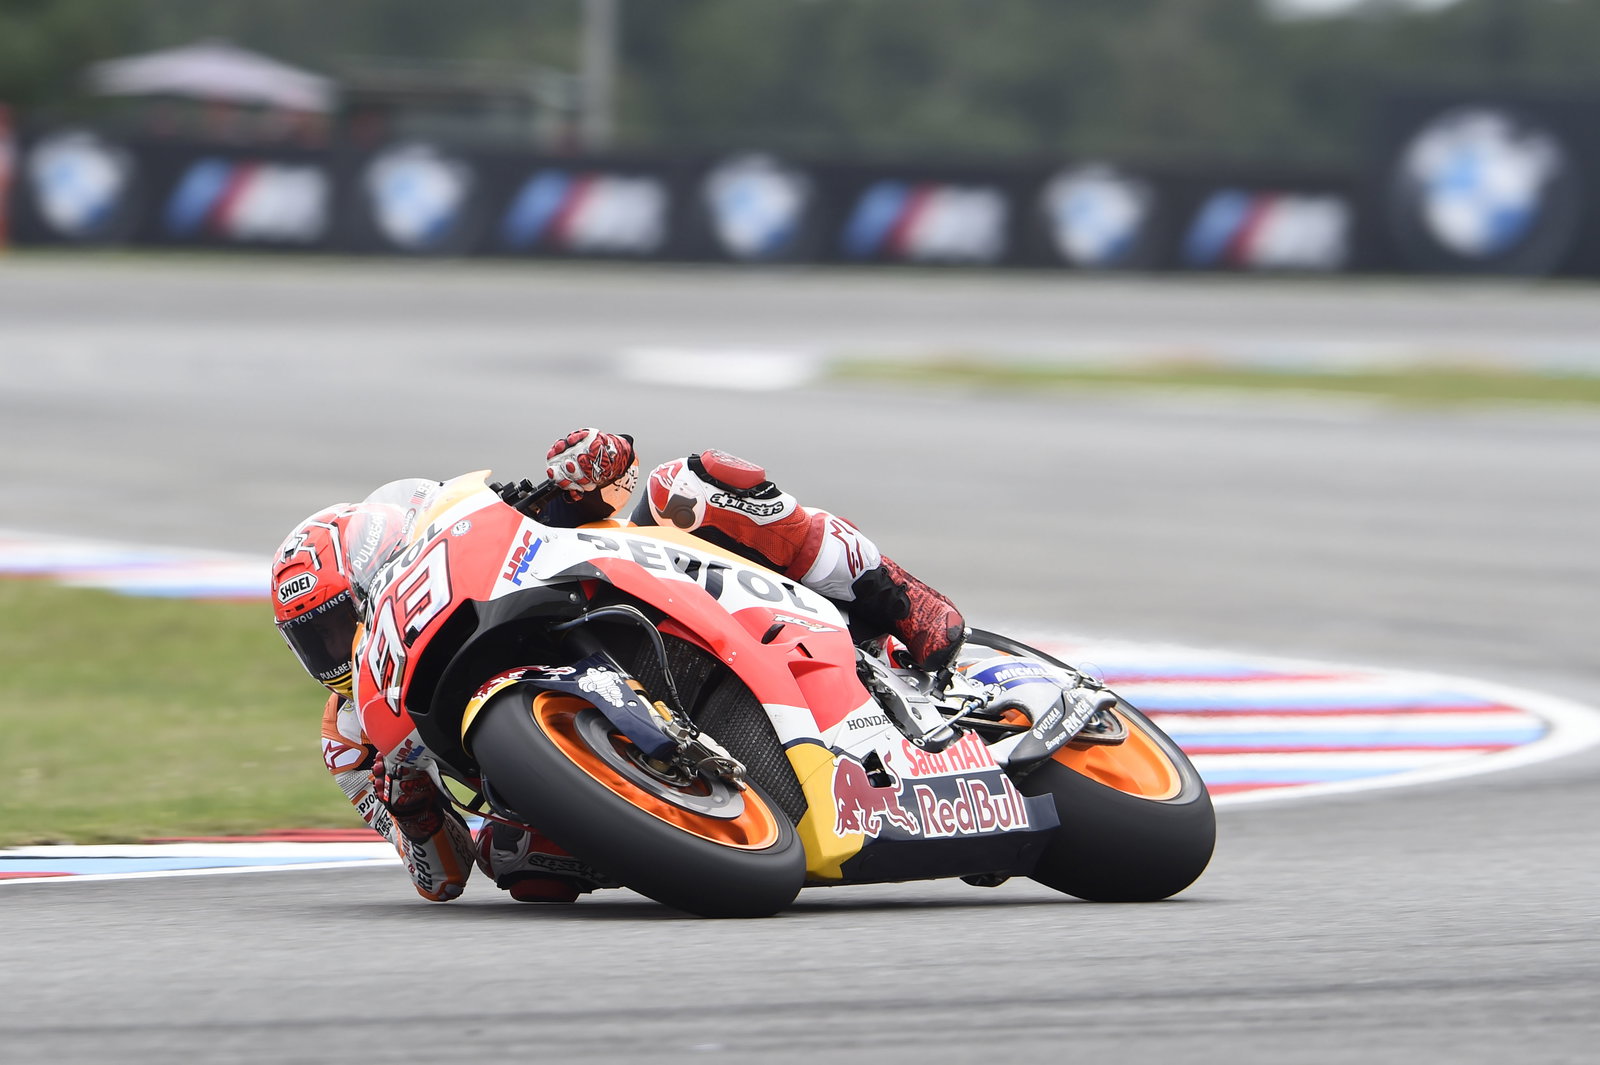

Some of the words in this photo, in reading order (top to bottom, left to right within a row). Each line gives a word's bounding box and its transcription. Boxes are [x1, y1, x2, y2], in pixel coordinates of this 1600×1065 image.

[711, 493, 784, 517] alpinestars
[503, 530, 542, 586] HRC
[280, 576, 311, 600] SHOEI
[294, 612, 313, 625] YOU
[367, 537, 453, 717] 93
[320, 660, 352, 680] PULL&BEA
[847, 714, 891, 731] HONDA
[1037, 708, 1061, 733] YUTAKA
[1062, 712, 1083, 733] RK
[914, 779, 974, 838] Red
[968, 774, 1029, 832] Bull
[412, 843, 433, 894] REPSO
